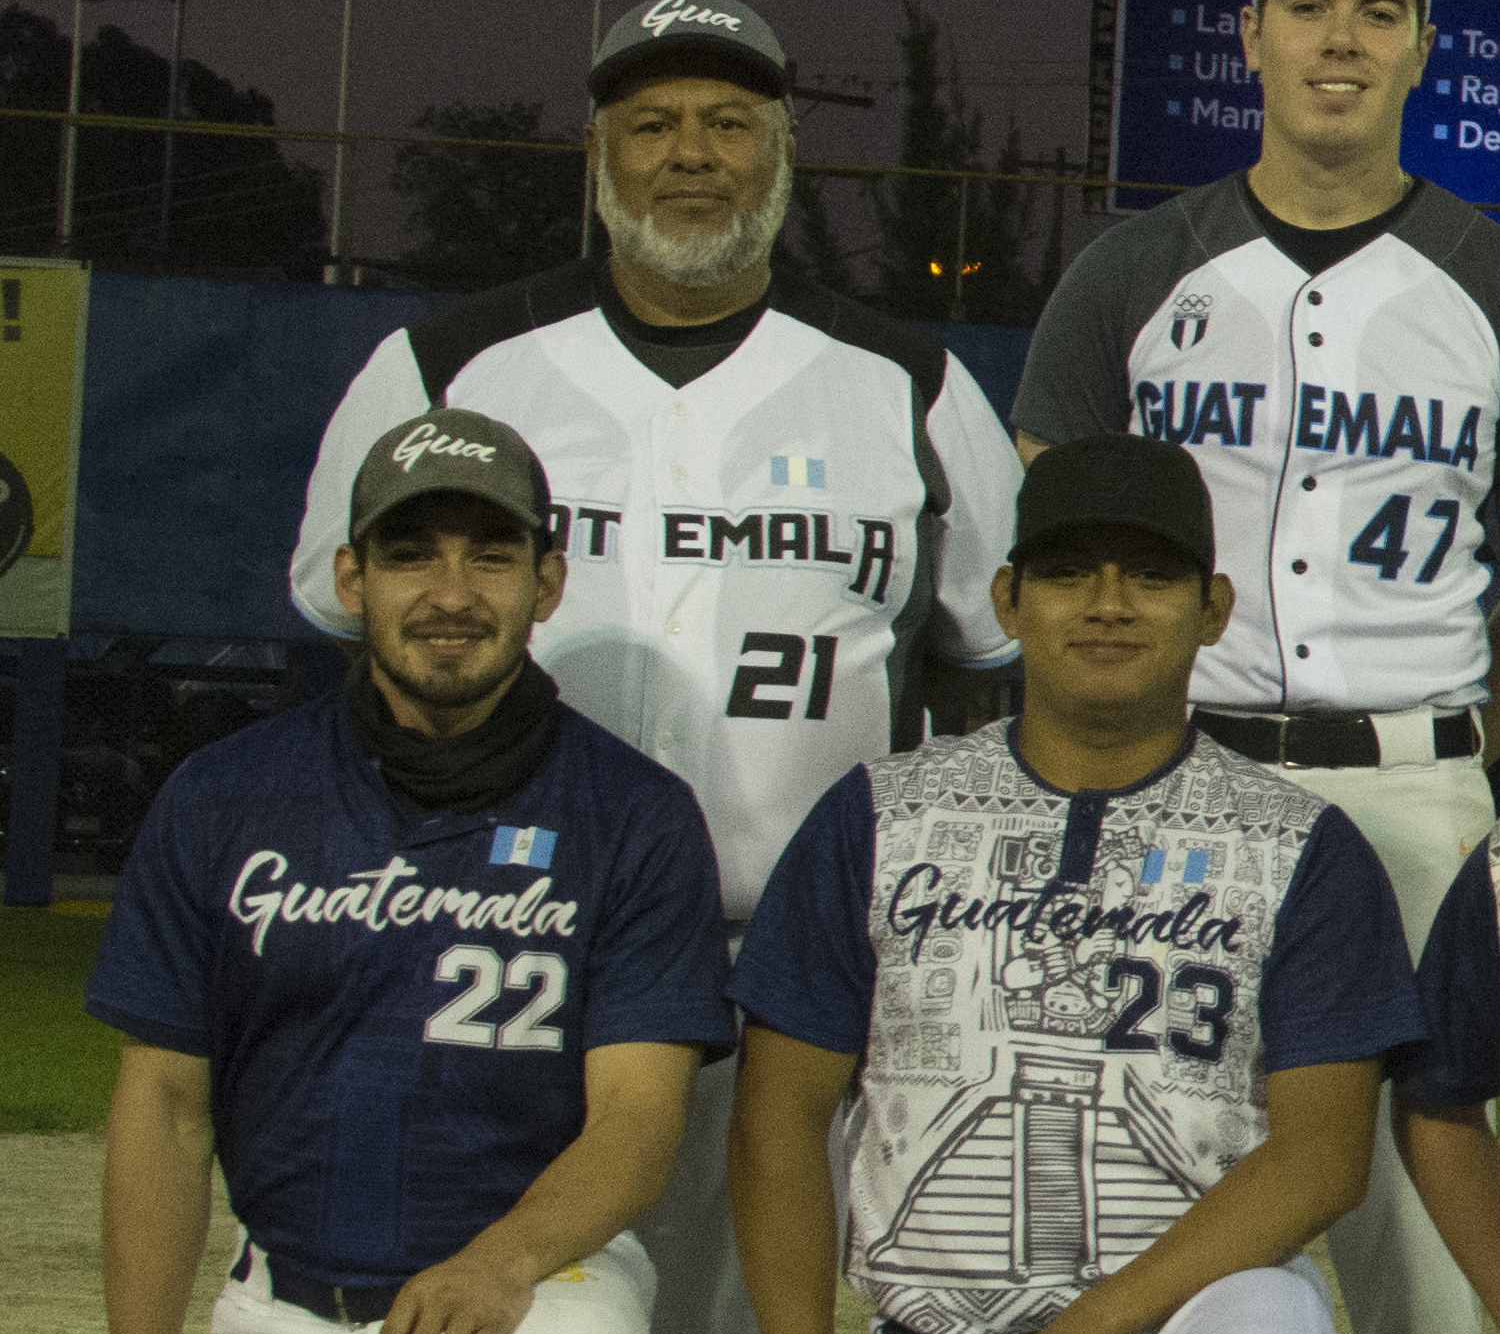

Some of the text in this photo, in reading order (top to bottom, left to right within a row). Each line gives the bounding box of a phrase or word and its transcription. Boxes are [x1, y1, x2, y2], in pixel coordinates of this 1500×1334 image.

[392, 423, 498, 473] Gua
[1348, 493, 1460, 584] 47
[725, 631, 840, 721] 21
[228, 849, 577, 957] Guatemala
[886, 863, 1242, 964] Guatemala
[422, 944, 569, 1053] 22
[1104, 956, 1233, 1064] 23
